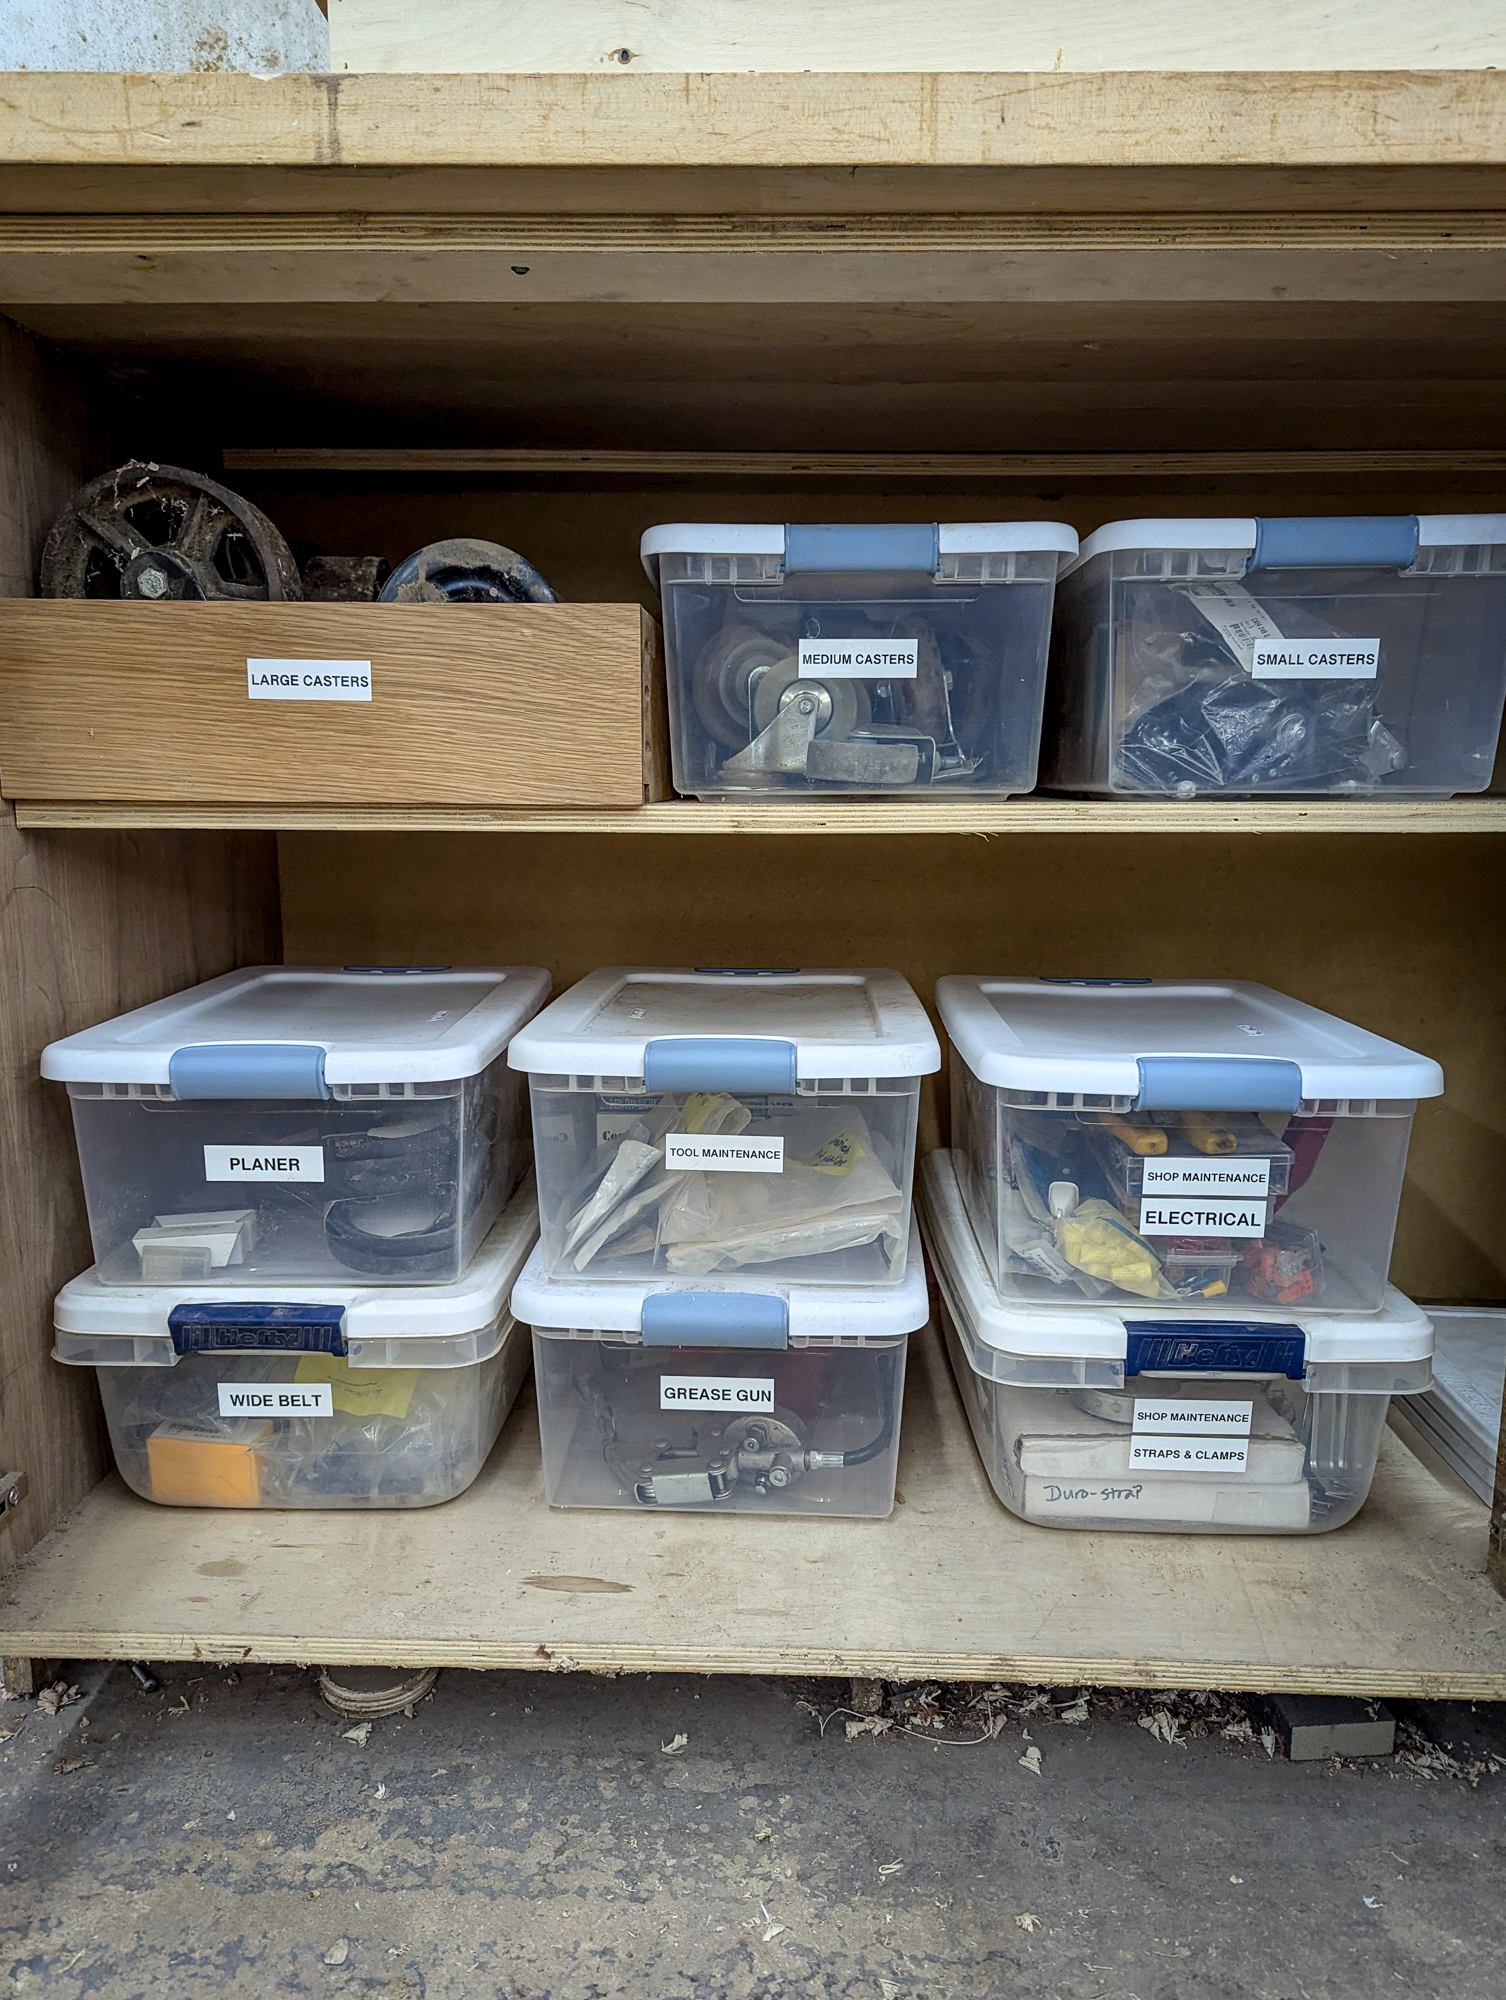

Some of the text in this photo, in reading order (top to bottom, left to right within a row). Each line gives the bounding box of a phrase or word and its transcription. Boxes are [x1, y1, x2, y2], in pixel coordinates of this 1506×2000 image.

[802, 653, 915, 665] MEDIUM CASTERS
[1256, 653, 1374, 666] SMALL CASTERS
[251, 673, 370, 688] LARGE CASTERS
[669, 1147, 782, 1160] TOOL MAINTENANCE
[229, 1157, 301, 1172] PLANER
[1147, 1171, 1268, 1184] SHOP MAINTENANCE
[1145, 1210, 1262, 1227] ELECTRICAL
[229, 1393, 322, 1407] WIDE BELT
[663, 1386, 773, 1404] GREASE GUN
[1137, 1411, 1250, 1424] SHOP MAINTENANCE
[1133, 1448, 1245, 1462] STRAPS & CLAMPS
